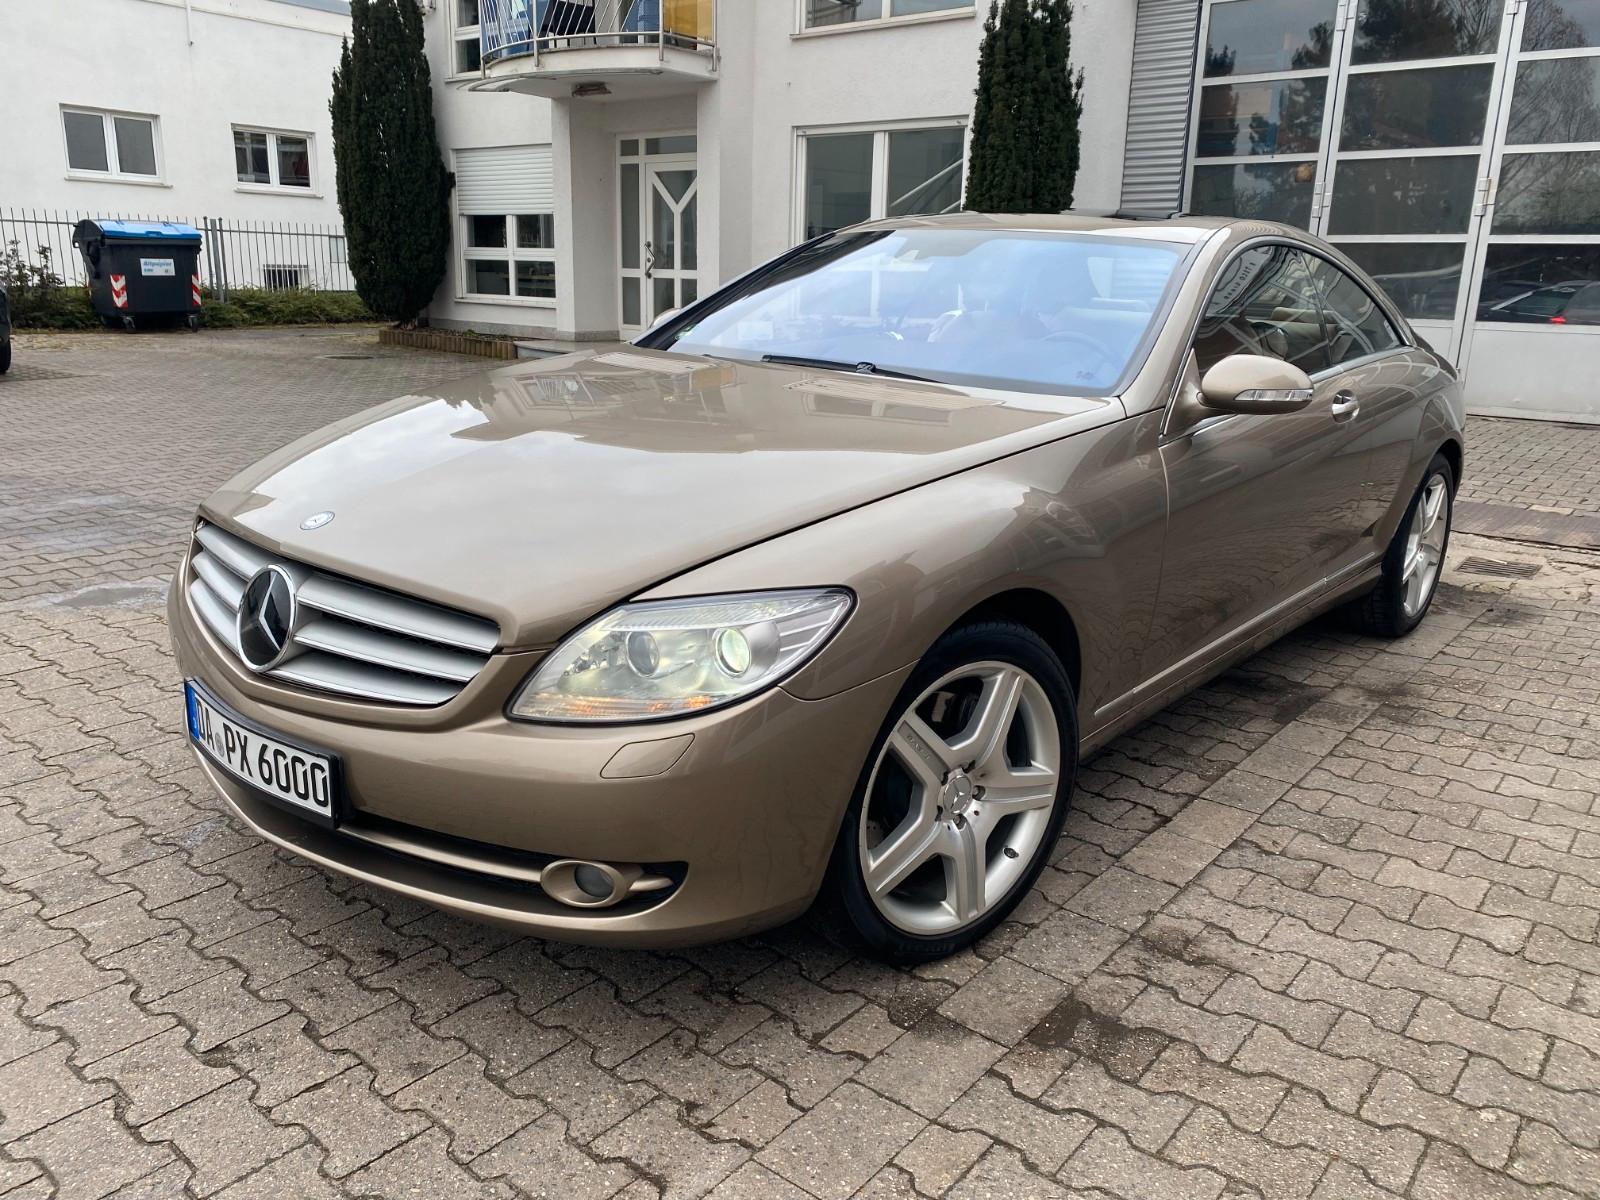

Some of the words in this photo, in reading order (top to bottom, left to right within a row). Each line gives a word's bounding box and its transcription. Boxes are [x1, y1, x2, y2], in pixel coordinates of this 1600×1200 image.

[196, 697, 215, 750] DA
[223, 722, 253, 777] PX
[258, 743, 329, 807] 6000
